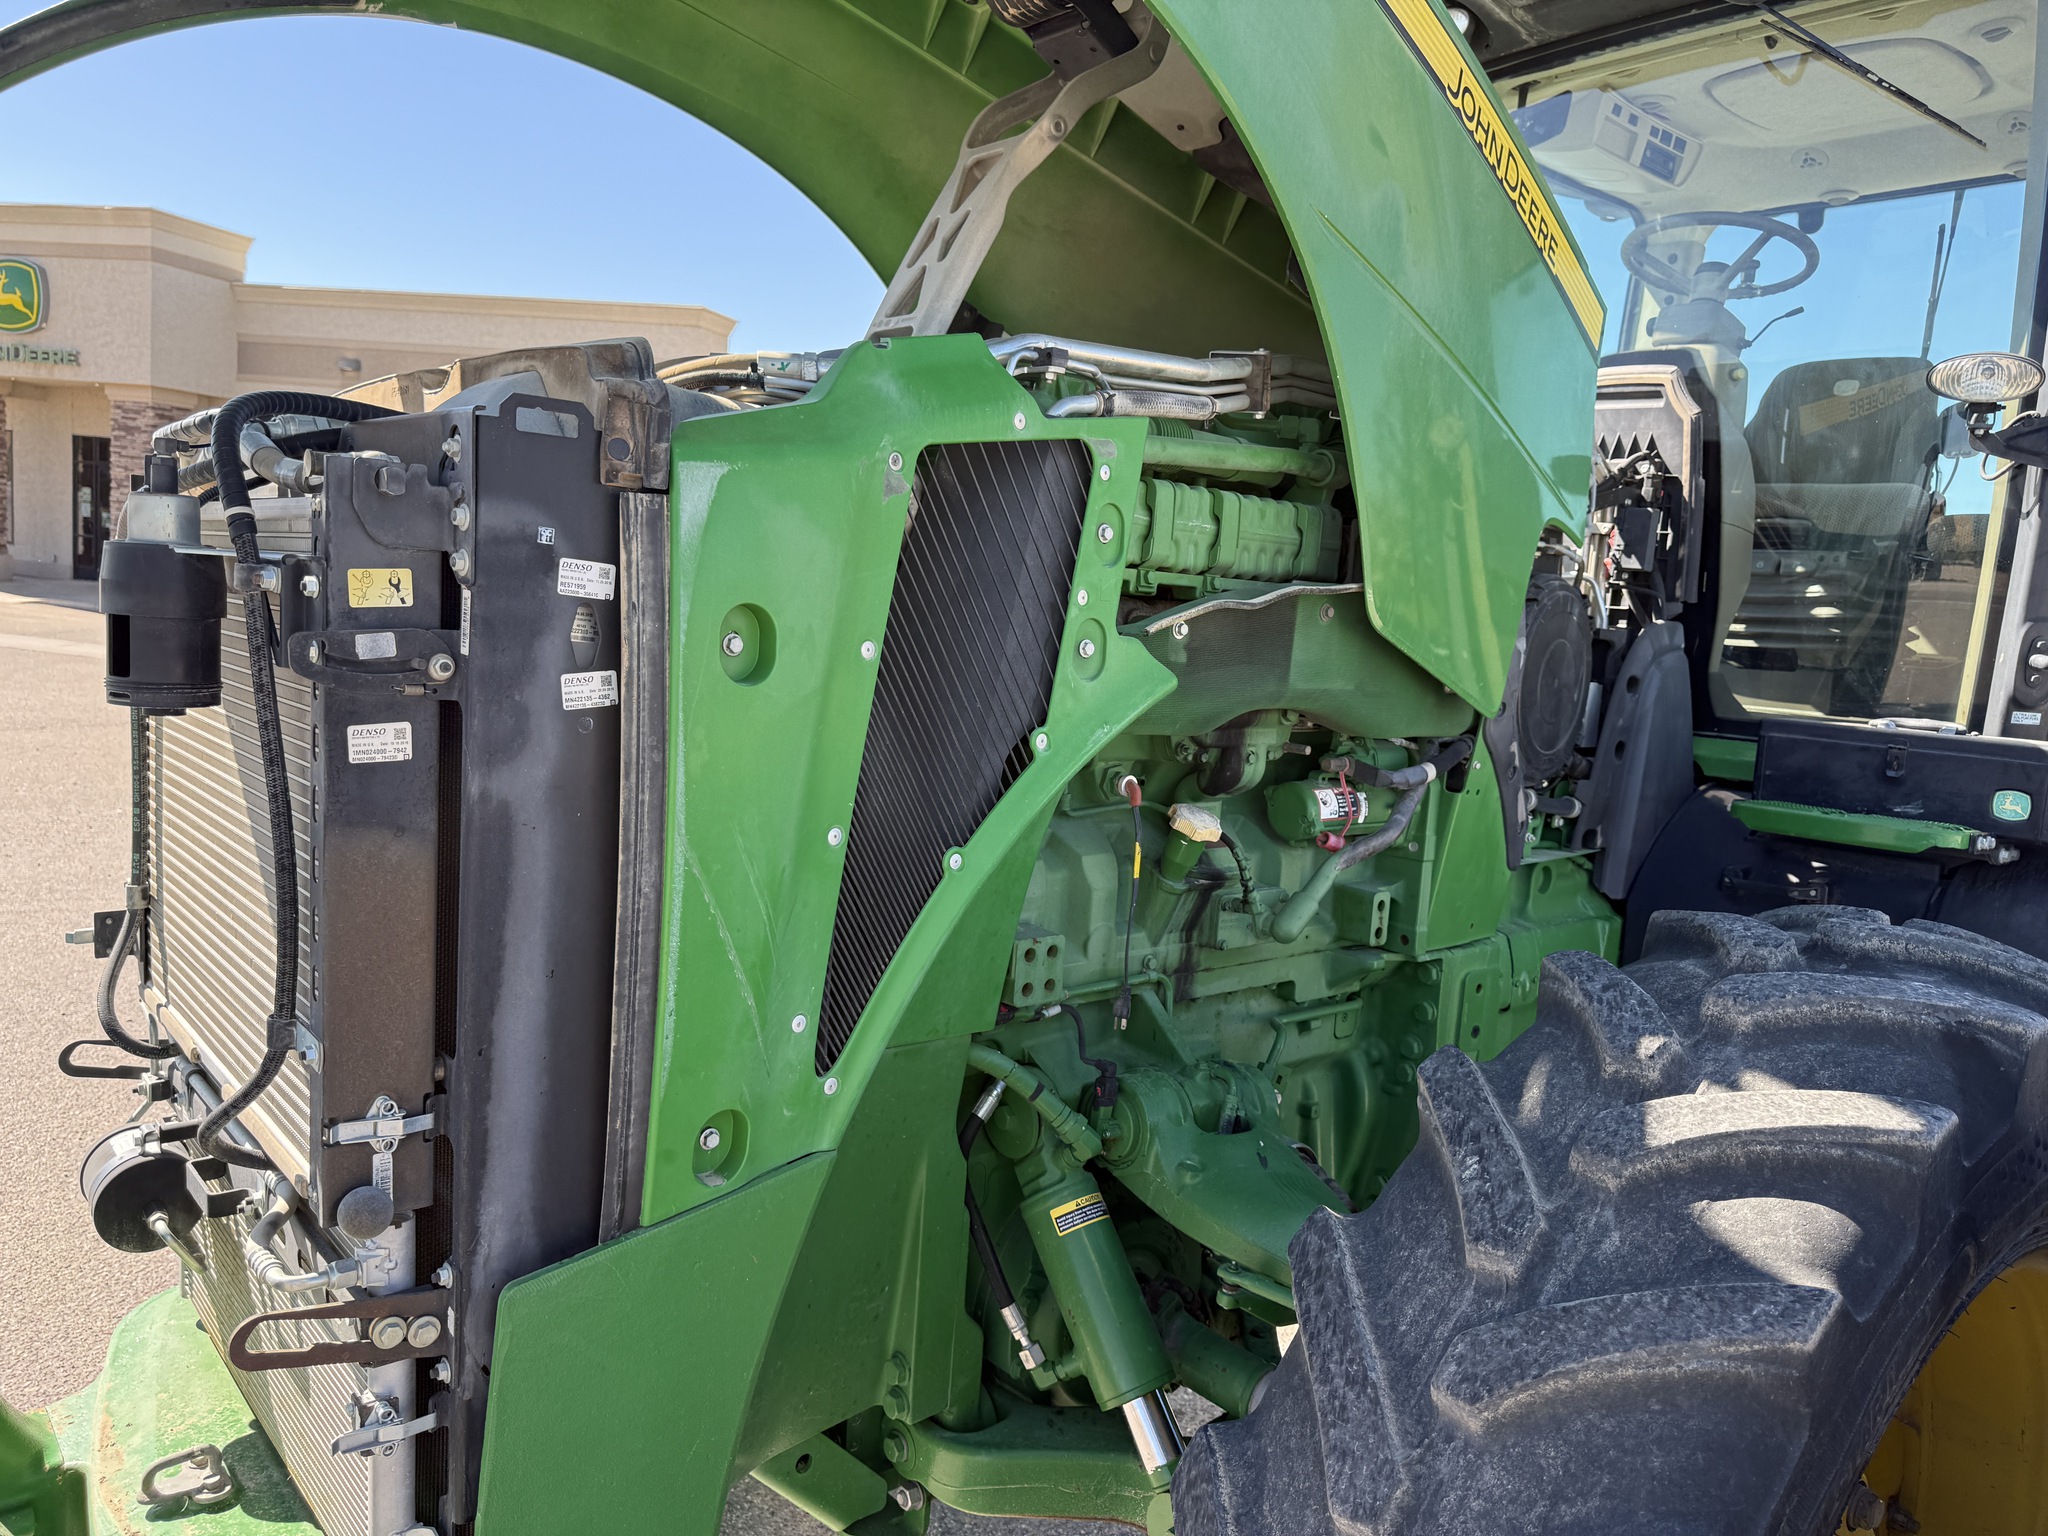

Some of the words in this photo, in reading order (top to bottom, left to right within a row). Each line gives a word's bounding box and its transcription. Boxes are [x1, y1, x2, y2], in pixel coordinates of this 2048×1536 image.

[561, 562, 593, 572] DENSO
[564, 676, 594, 685] DENSO
[352, 728, 386, 736] DENSO
